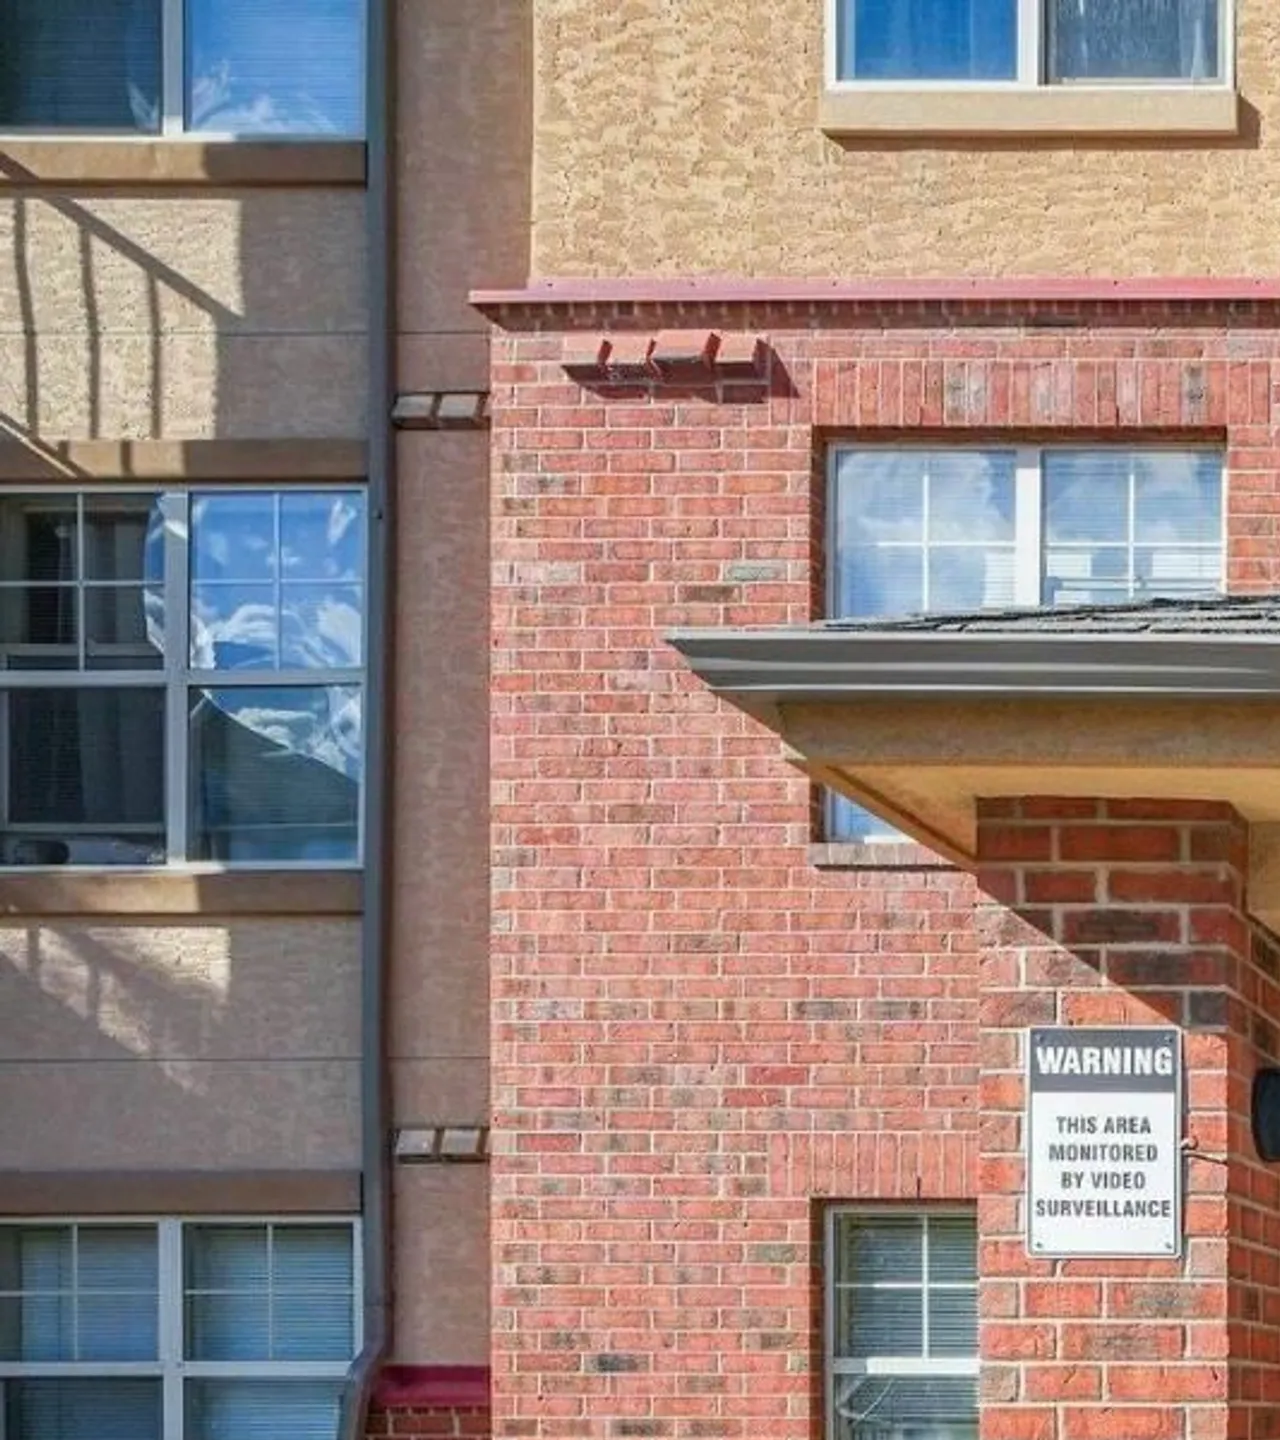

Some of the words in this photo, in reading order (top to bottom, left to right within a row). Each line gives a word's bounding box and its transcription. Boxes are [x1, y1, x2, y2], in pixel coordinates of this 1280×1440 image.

[1036, 1047, 1172, 1075] WARNING
[1057, 1116, 1098, 1134] THIS
[1103, 1116, 1151, 1134] AREA
[1049, 1144, 1158, 1162] MONITORED
[1061, 1172, 1085, 1189] BY
[1091, 1172, 1146, 1189] VIDEO
[1036, 1200, 1171, 1218] SURVEILLANCE
